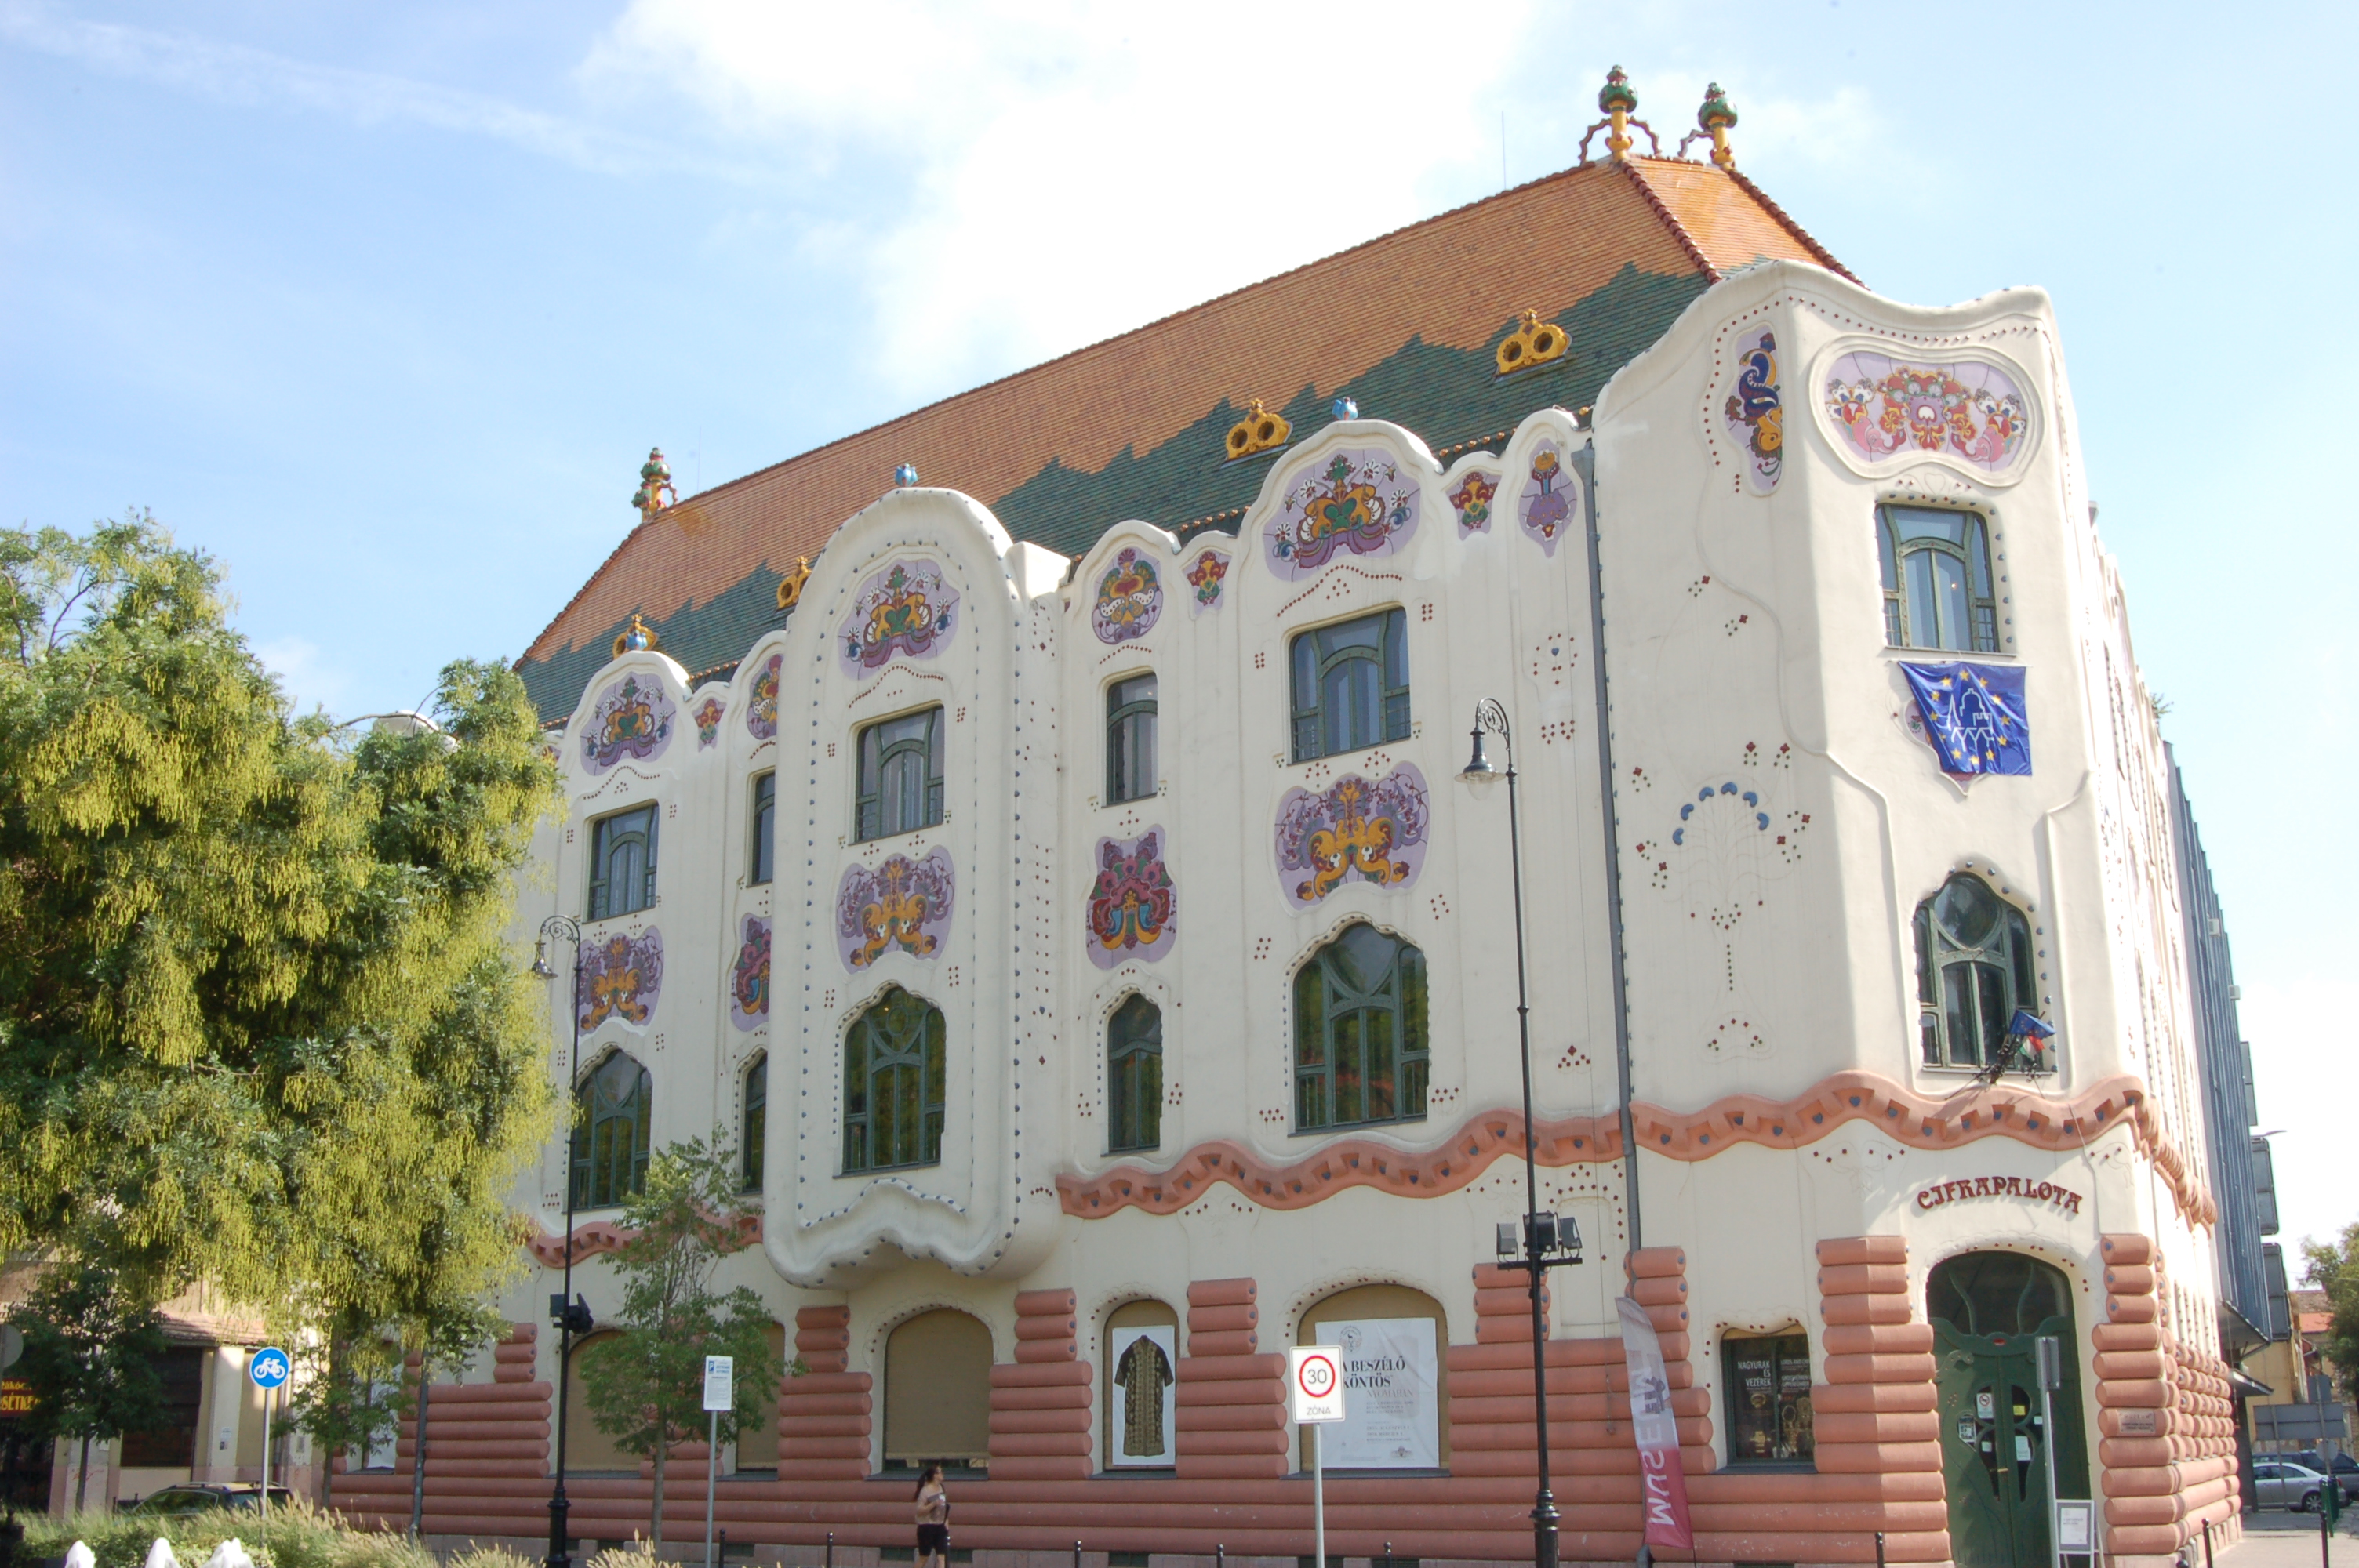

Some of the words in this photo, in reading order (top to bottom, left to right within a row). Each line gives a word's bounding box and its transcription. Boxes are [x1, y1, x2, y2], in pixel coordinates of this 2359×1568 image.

[1917, 1175, 2083, 1214] CIFRAPALOTA
[1351, 1355, 1405, 1372] BESZÉLŐ
[1307, 1369, 1327, 1385] 30
[1746, 1377, 1772, 1387] VEZÉREK
[1307, 1404, 1331, 1415] ZÓNA
